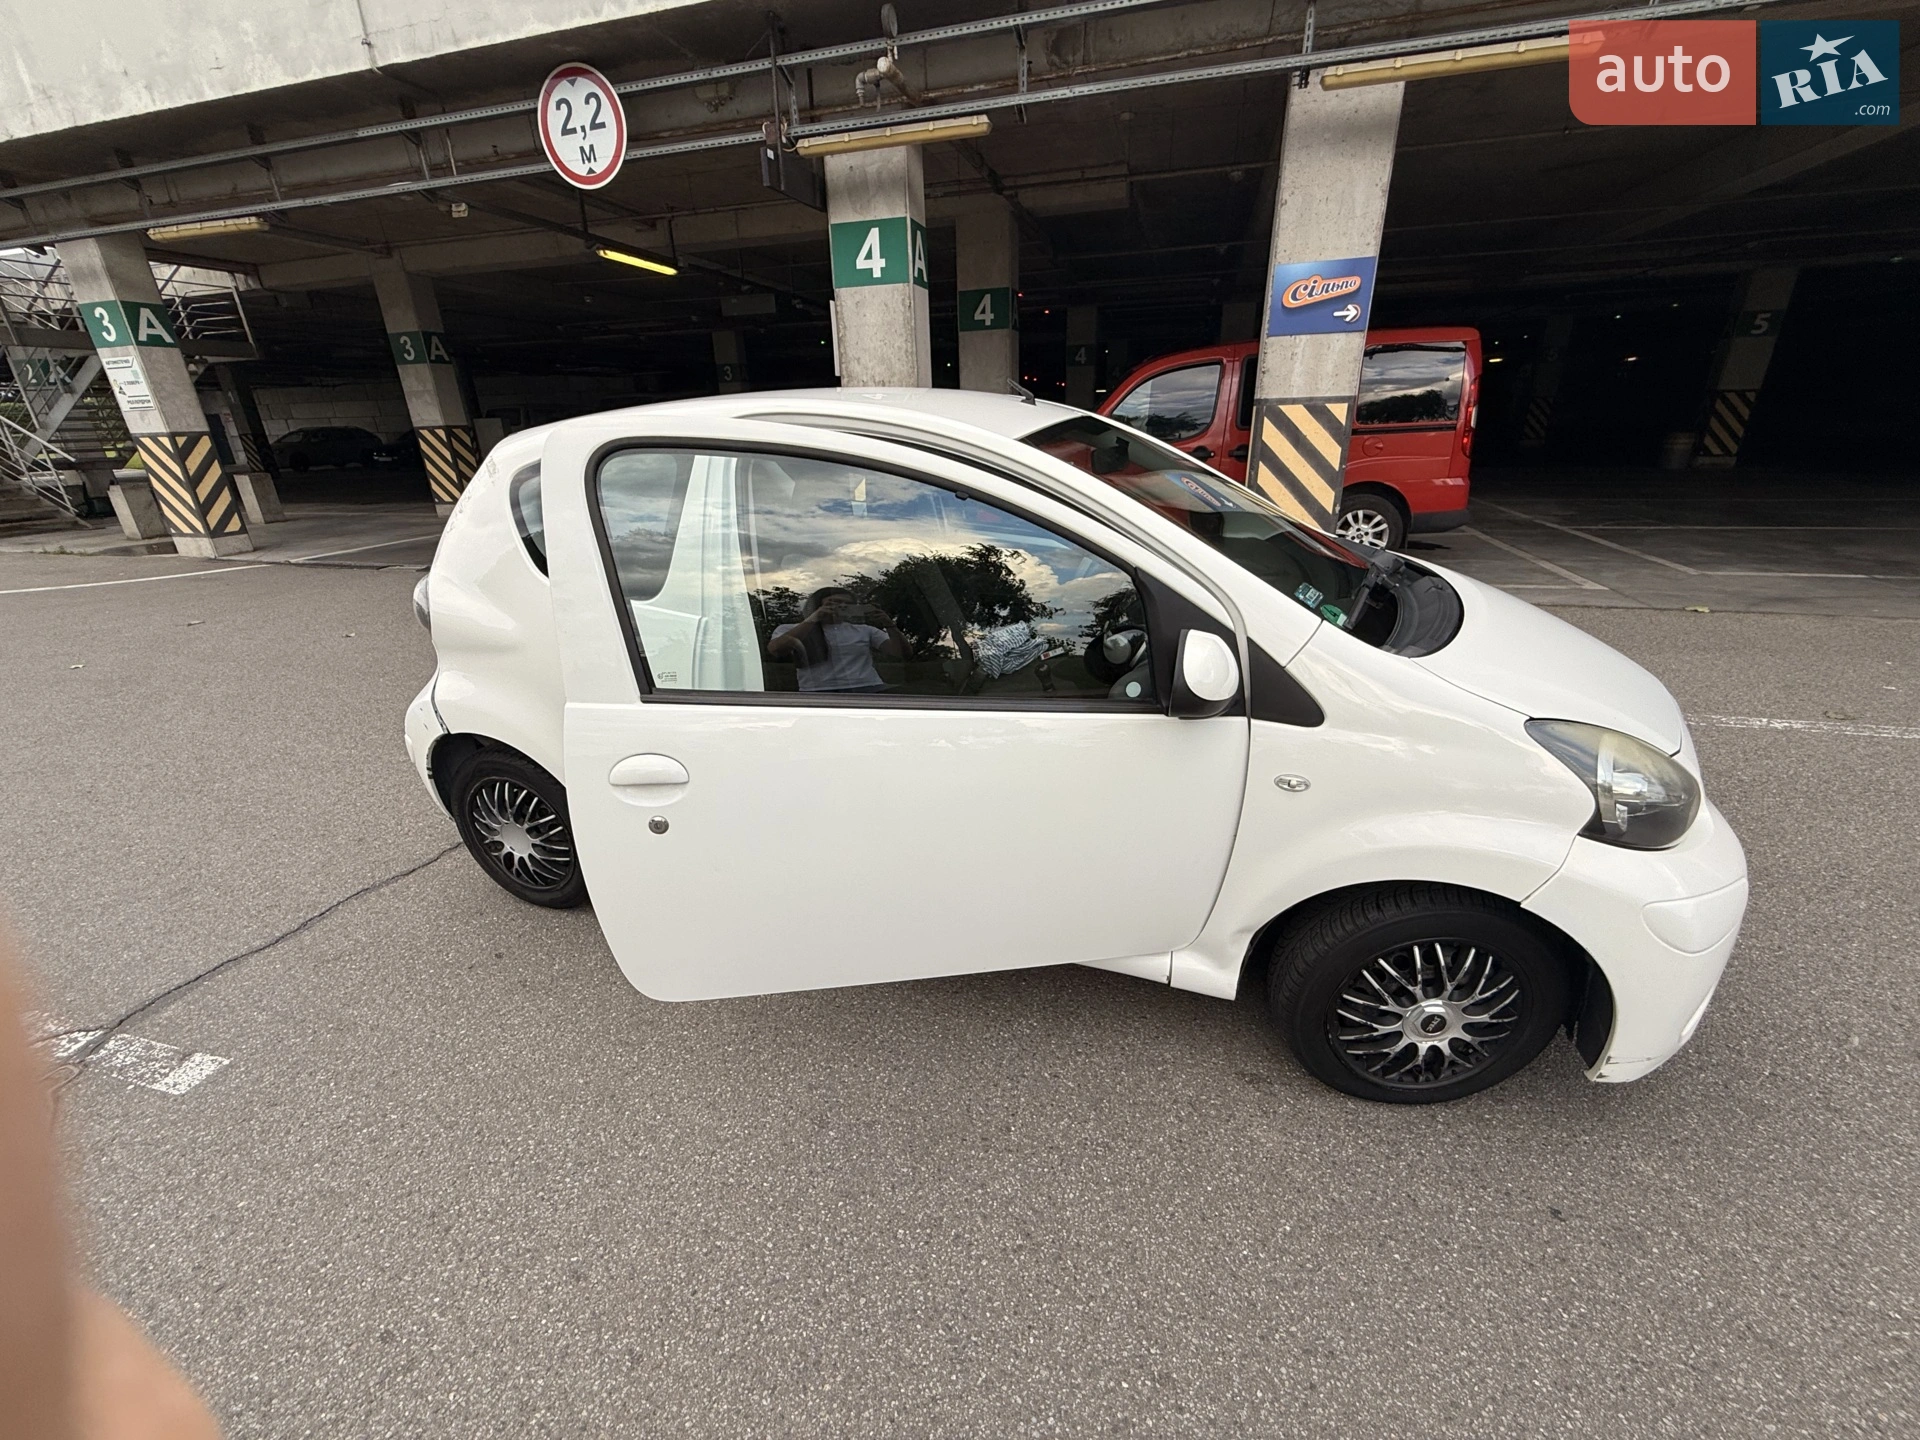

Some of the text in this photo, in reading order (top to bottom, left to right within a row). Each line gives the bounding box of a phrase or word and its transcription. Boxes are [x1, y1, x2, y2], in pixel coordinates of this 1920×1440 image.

[555, 91, 607, 141] 2,2
[856, 227, 886, 278] 4
[1289, 279, 1357, 303] Сільпо
[974, 293, 995, 326] 4
[94, 306, 117, 342] 3
[1751, 313, 1772, 335] 5
[400, 335, 415, 361] 3
[1075, 346, 1087, 364] 4
[723, 365, 733, 381] 3
